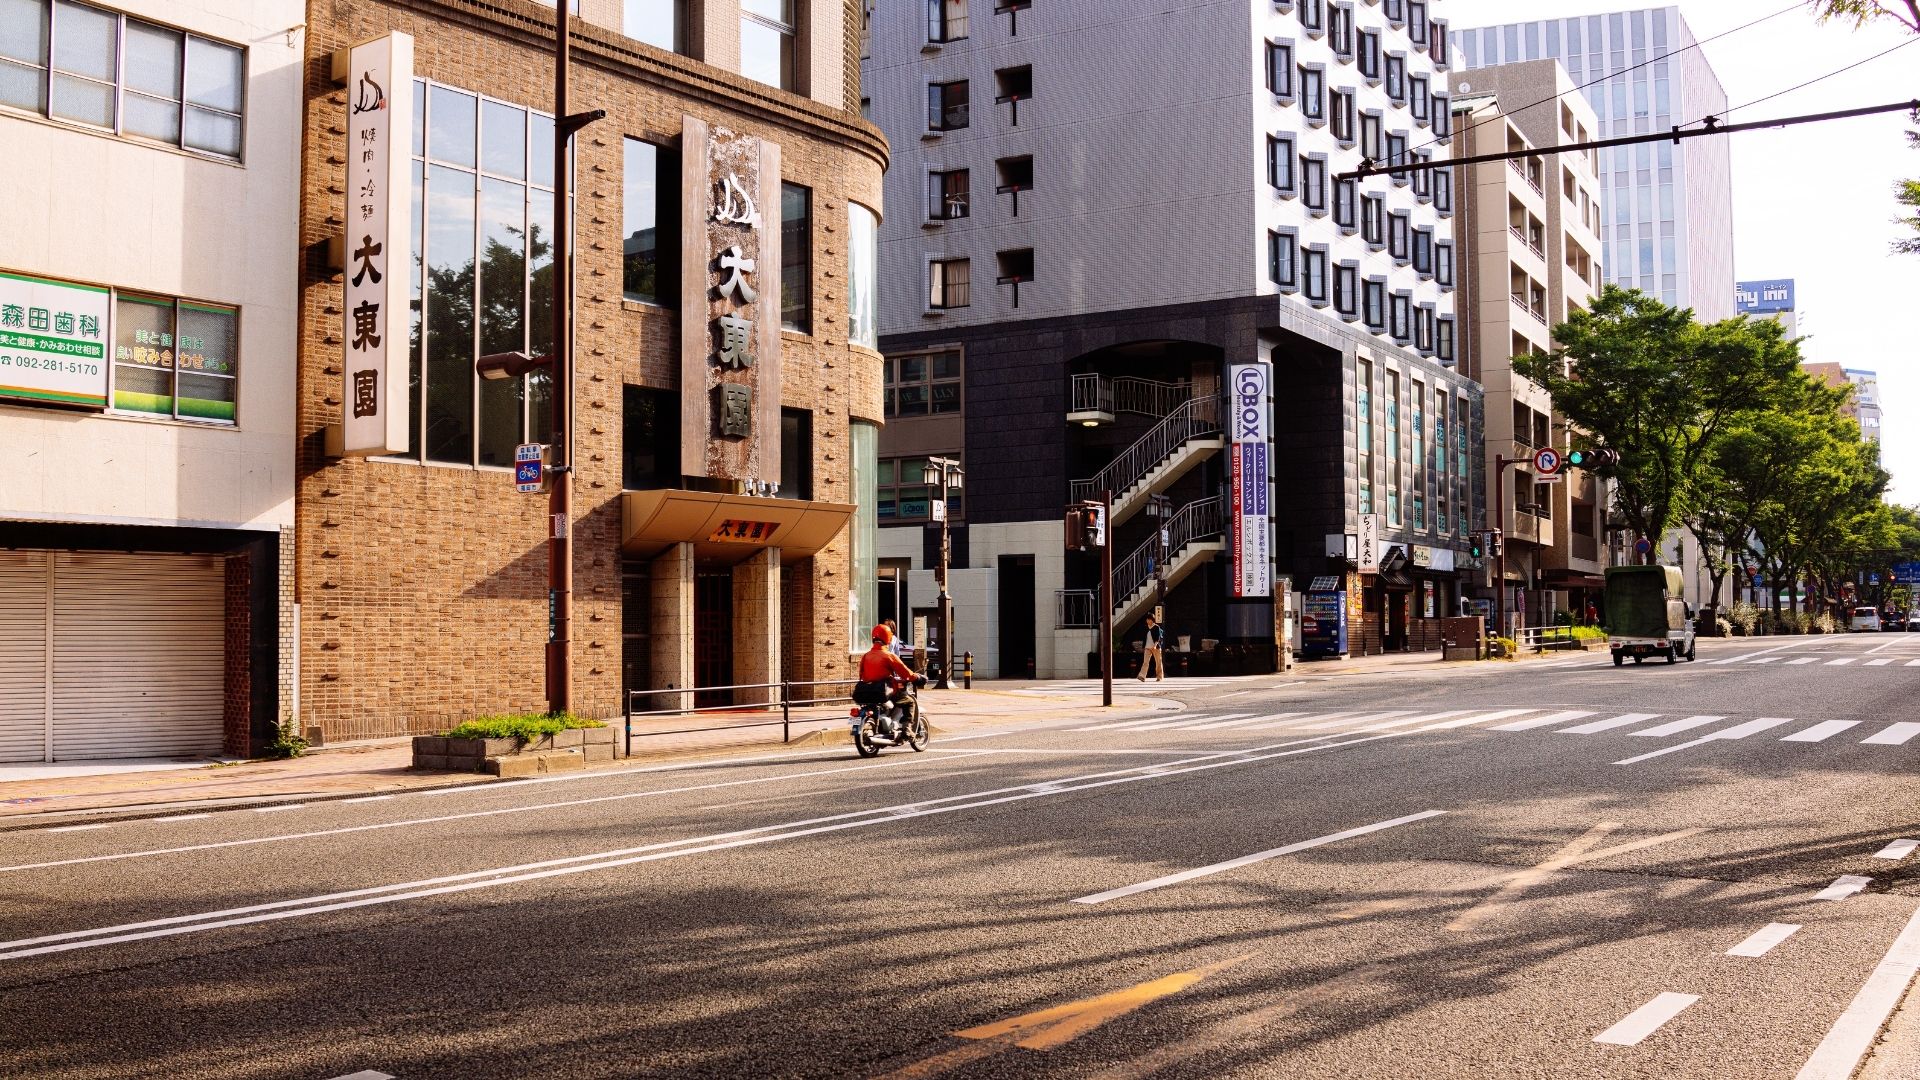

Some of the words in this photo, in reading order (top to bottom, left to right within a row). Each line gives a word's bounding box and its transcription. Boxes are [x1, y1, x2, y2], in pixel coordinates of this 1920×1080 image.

[1763, 290, 1788, 301] inn
[2, 304, 101, 338] 森田歯科
[352, 234, 382, 419] 大東園
[717, 244, 757, 438] 大東園
[16, 356, 98, 376] 092-281-5170
[1242, 373, 1259, 438] LCBOX
